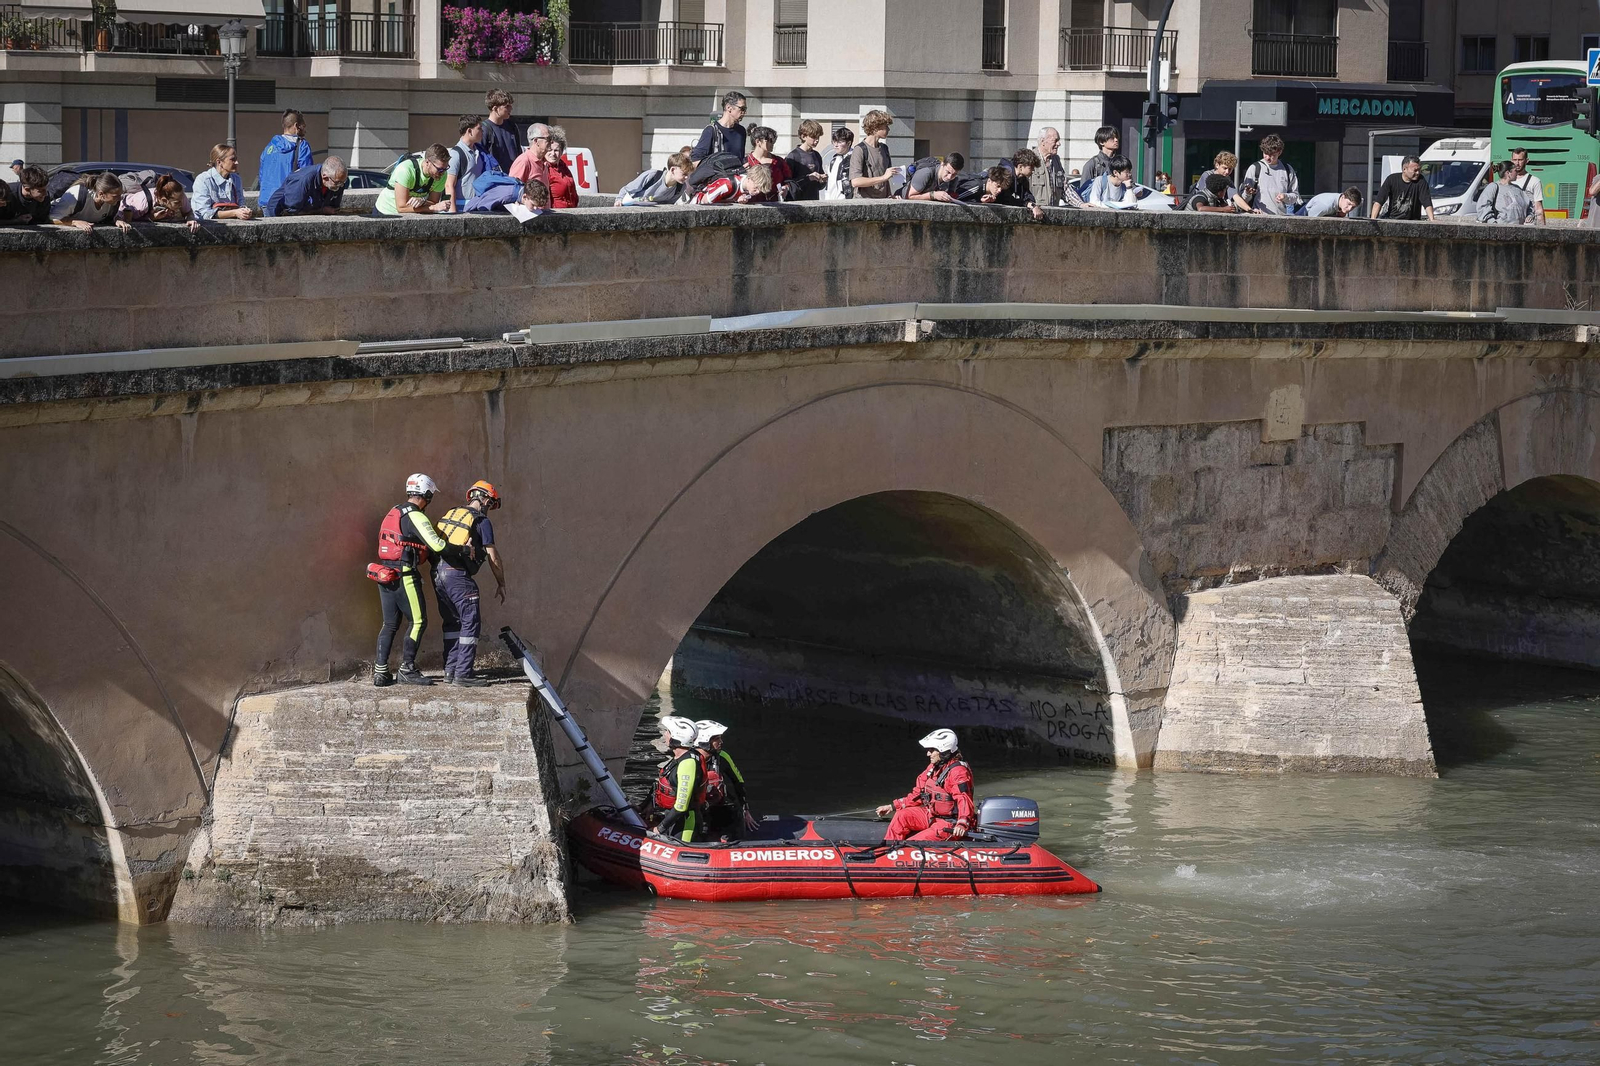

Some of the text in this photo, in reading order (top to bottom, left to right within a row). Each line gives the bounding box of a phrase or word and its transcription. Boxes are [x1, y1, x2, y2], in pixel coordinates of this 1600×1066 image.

[1318, 98, 1415, 116] MERCADONA
[1030, 700, 1057, 720] NO
[1048, 720, 1110, 744] DROGA
[1011, 810, 1036, 818] YAMAHA
[597, 827, 677, 859] RESCATE
[730, 849, 836, 862] BOMBEROS
